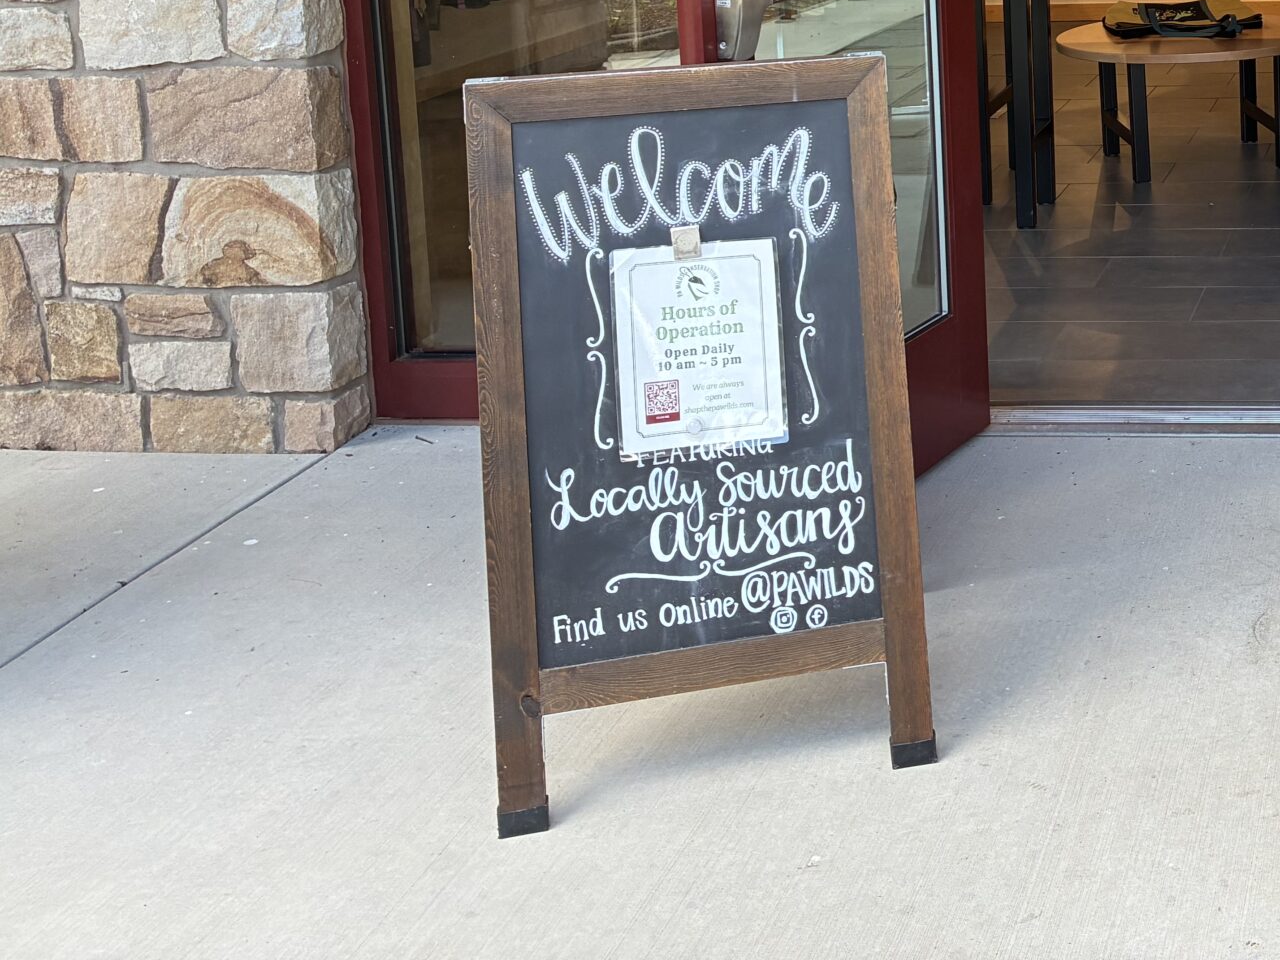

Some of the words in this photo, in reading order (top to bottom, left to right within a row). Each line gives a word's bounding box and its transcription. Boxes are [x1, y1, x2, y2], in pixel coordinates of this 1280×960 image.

[518, 126, 841, 262] Welcome
[661, 303, 716, 322] Hours
[720, 299, 738, 316] of
[655, 320, 745, 343] Operation
[664, 346, 698, 360] Open
[701, 343, 735, 357] Daily
[658, 360, 672, 372] 10
[676, 361, 696, 370] am
[710, 356, 719, 367] 5
[722, 355, 743, 369] pm
[692, 383, 706, 392] We
[707, 383, 719, 391] are
[719, 380, 745, 391] always
[684, 400, 755, 415] shopthepawilds.com
[704, 394, 722, 404] open
[723, 392, 732, 401] at
[545, 467, 708, 532] Locally
[716, 438, 863, 509] Sourced
[552, 607, 605, 645] Find
[617, 608, 648, 633] us
[741, 561, 876, 614] @PAWILDS
